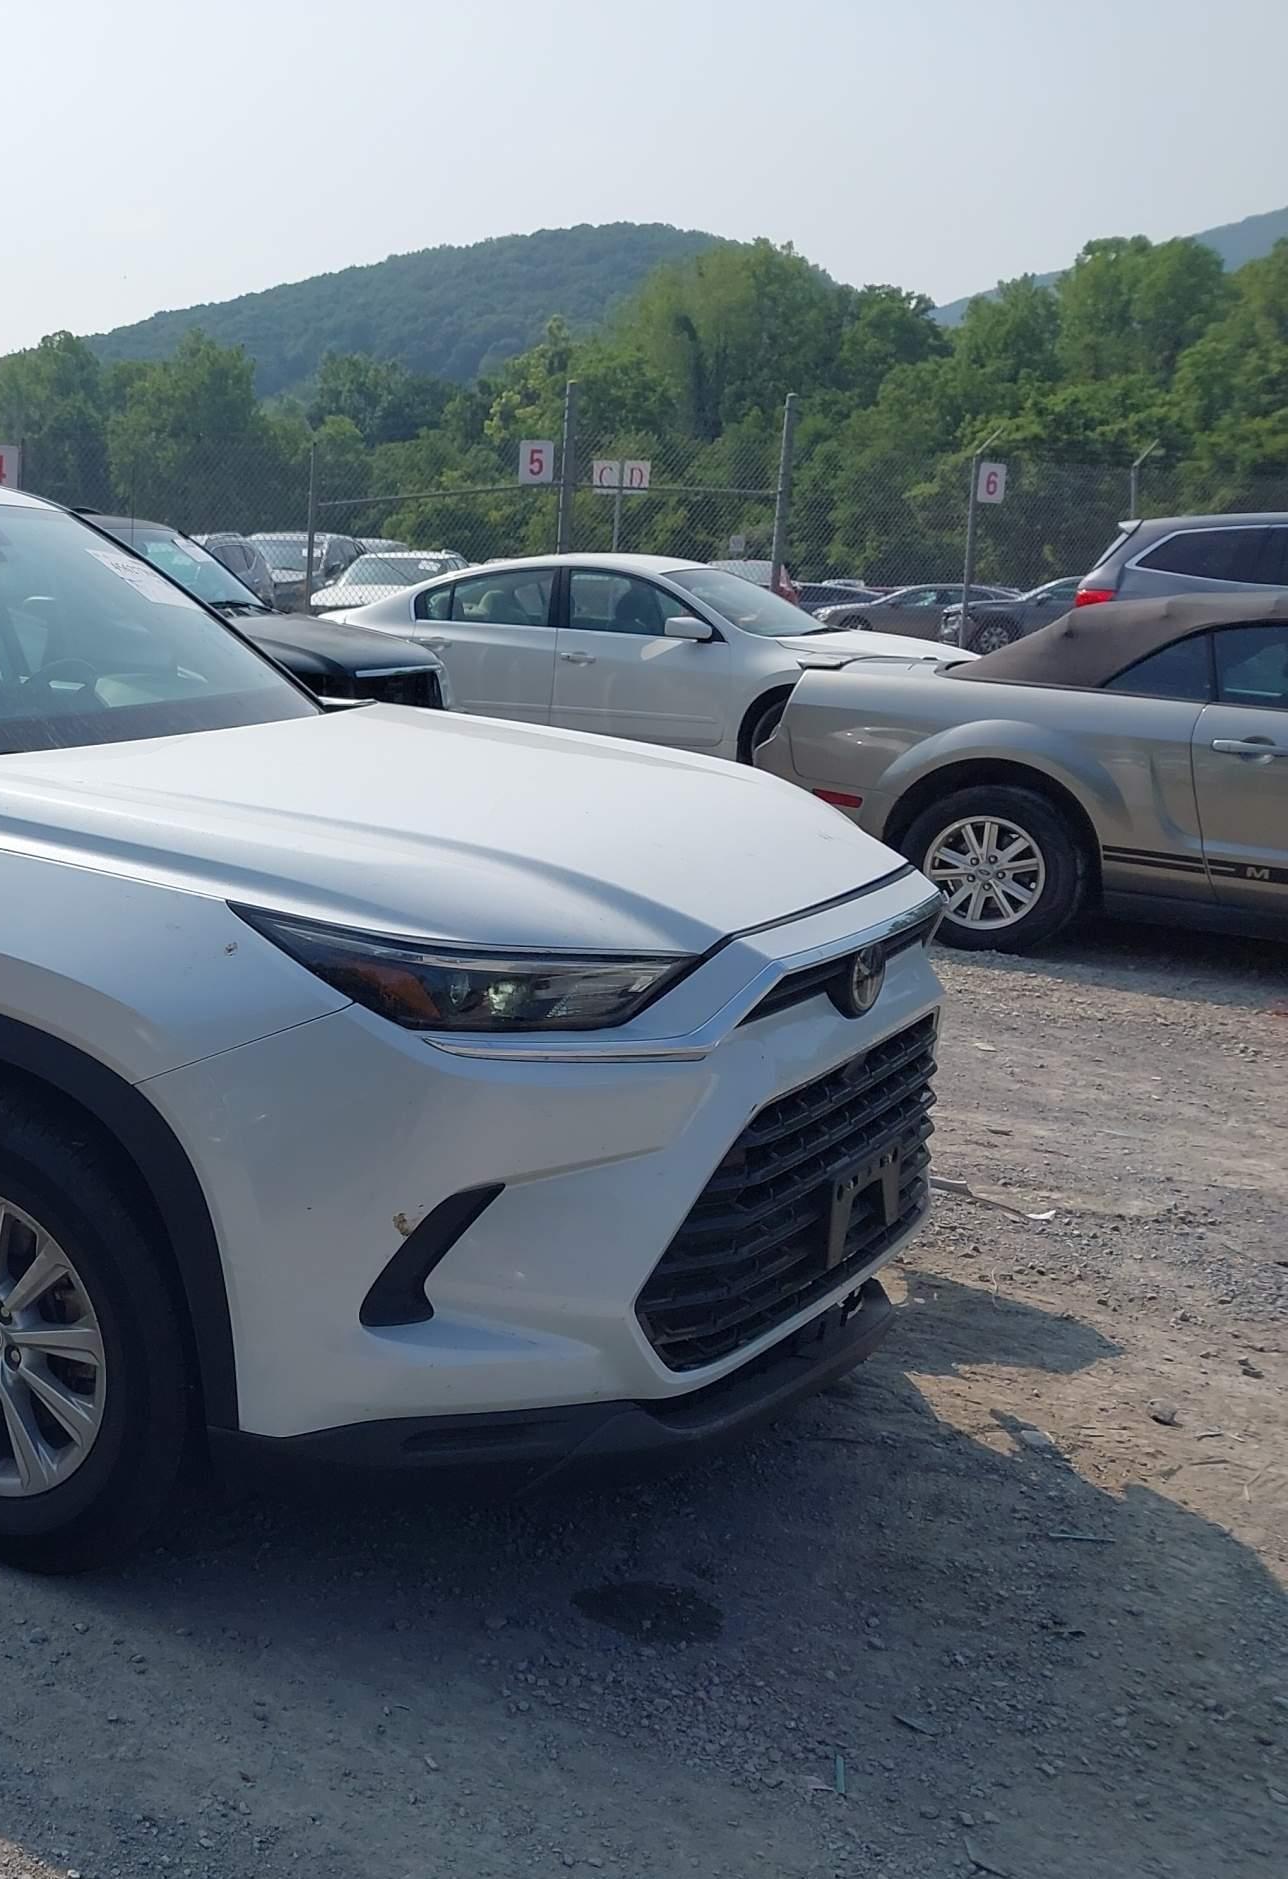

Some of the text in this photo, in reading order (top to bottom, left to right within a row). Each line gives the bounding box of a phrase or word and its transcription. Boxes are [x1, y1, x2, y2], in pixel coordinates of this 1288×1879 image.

[529, 449, 544, 475] 5
[599, 466, 613, 489] C
[629, 466, 644, 489] D
[986, 472, 998, 495] 6
[1247, 867, 1269, 879] M
